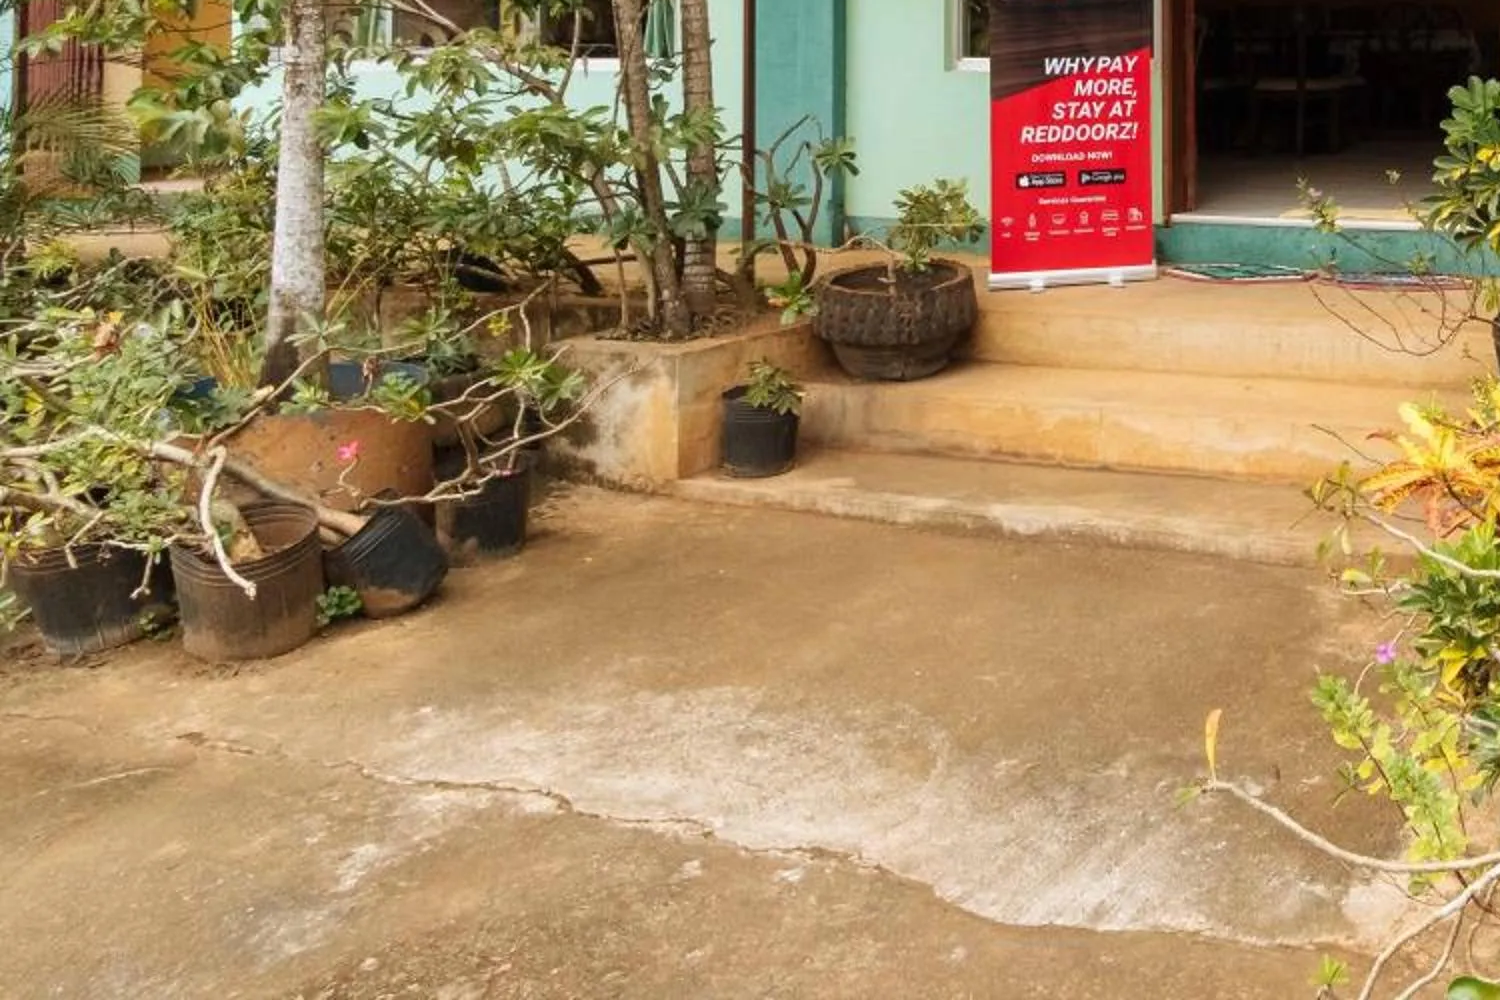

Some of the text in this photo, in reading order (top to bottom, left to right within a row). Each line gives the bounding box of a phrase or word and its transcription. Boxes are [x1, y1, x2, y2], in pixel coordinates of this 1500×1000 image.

[1044, 55, 1138, 75] WHY PAY
[1074, 78, 1137, 97] MORE,
[1052, 100, 1136, 120] STAY AT
[1021, 123, 1138, 143] REDDOORZ!
